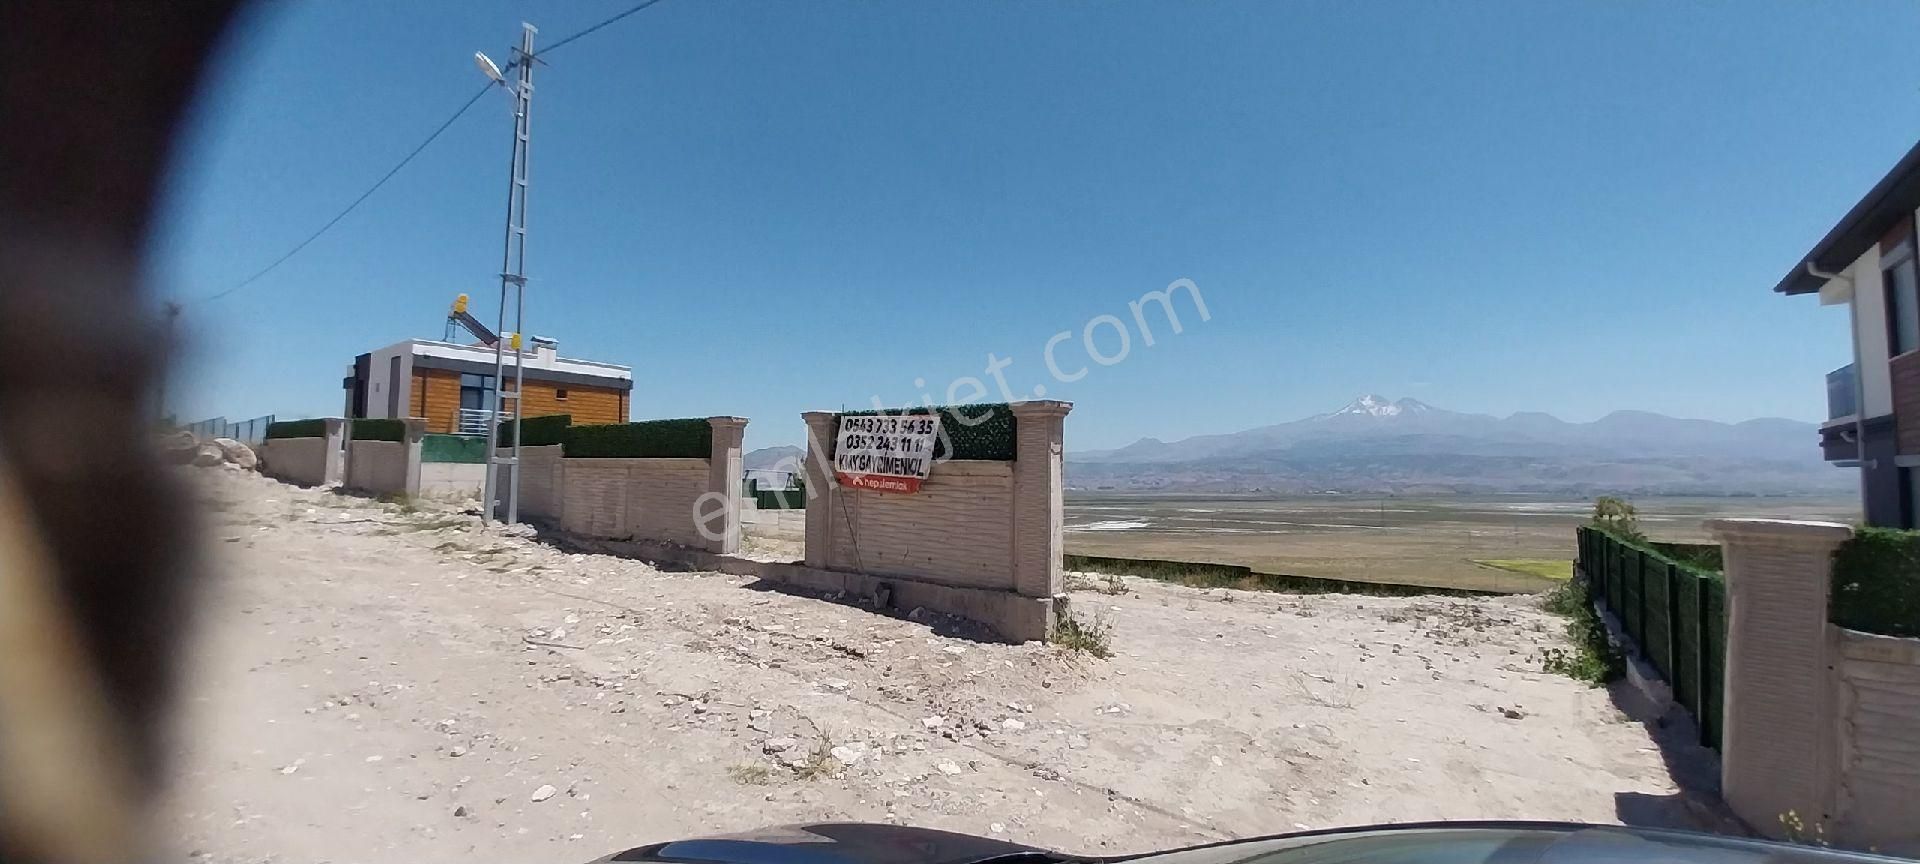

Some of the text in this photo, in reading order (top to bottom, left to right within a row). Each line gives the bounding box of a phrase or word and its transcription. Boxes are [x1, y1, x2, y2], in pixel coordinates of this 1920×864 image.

[845, 418, 933, 434] 0543 733 56 35
[846, 434, 874, 450] 0352
[876, 436, 897, 451] 243
[901, 437, 911, 452] 11
